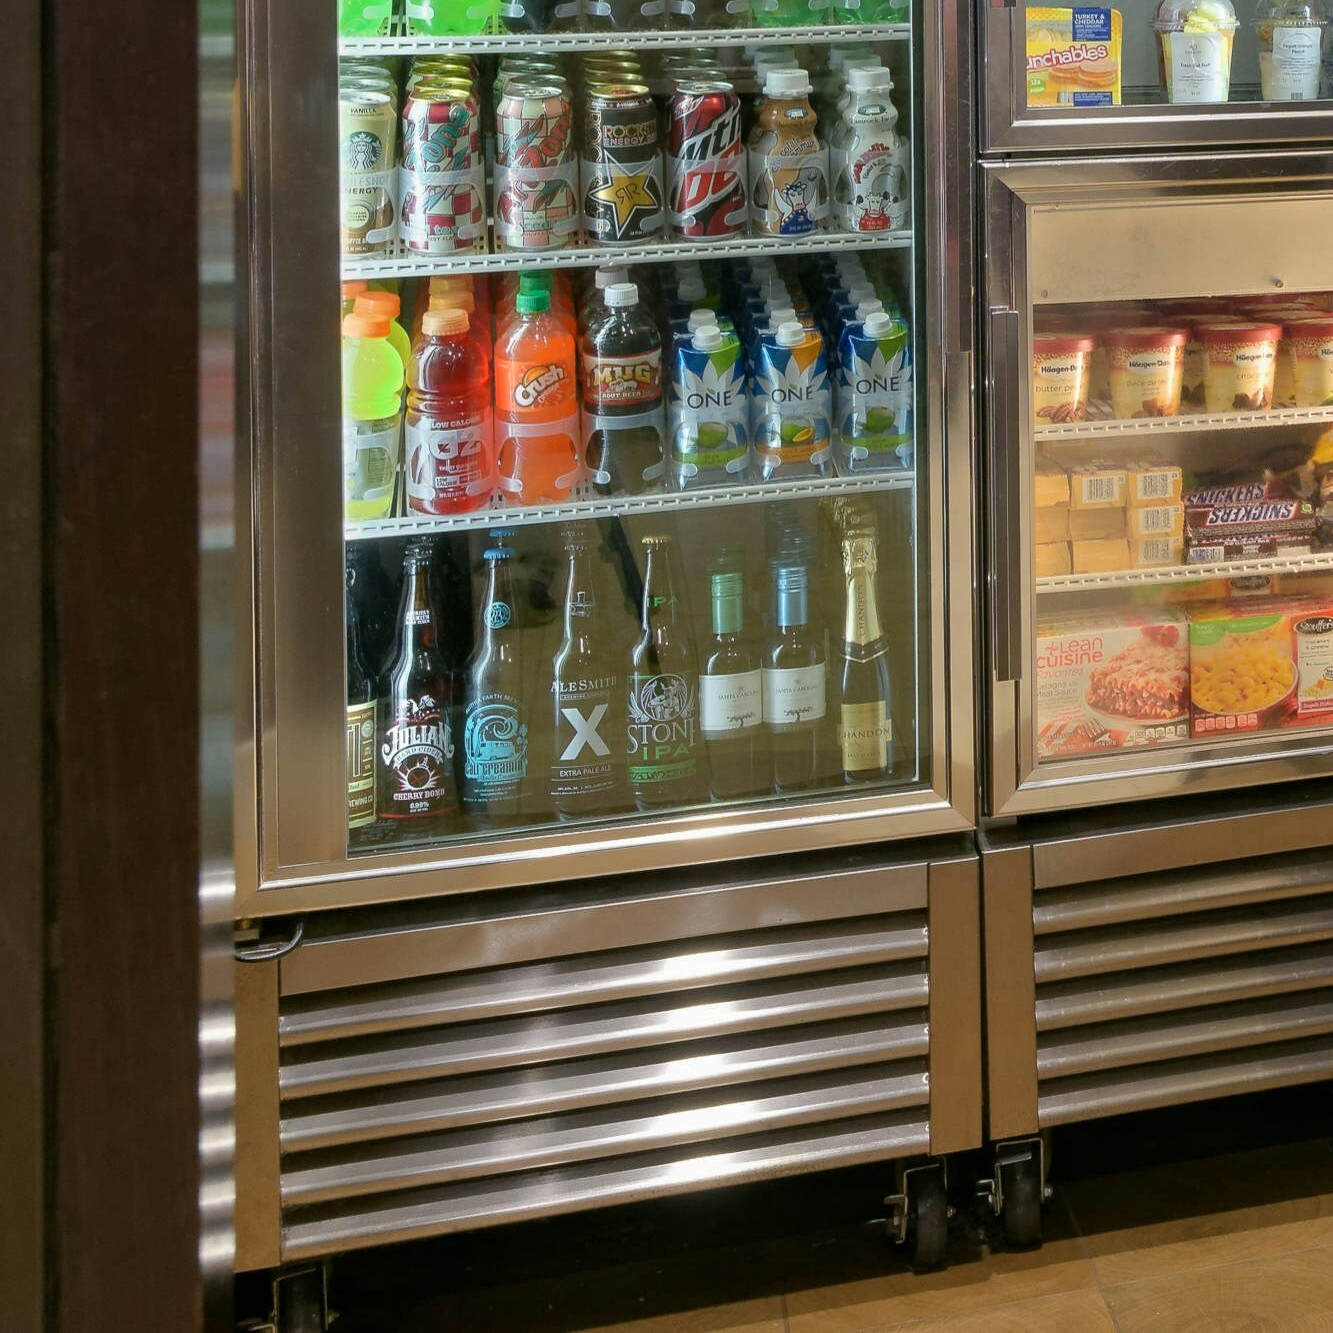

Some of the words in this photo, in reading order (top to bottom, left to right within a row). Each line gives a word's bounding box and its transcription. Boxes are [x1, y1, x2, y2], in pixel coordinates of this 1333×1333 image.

[1074, 18, 1104, 26] CHEDDAR
[1026, 45, 1107, 69] unchables
[350, 106, 377, 114] VANILLA
[593, 364, 650, 386] MUG
[513, 364, 566, 407] Crush
[622, 390, 642, 398] BEER
[771, 385, 814, 403] ONE
[856, 377, 900, 395] ONE
[687, 390, 733, 410] ONE
[430, 419, 449, 429] LOW
[1208, 503, 1297, 525] SNICKERS
[857, 586, 865, 637] CHANDON
[1059, 637, 1103, 654] Lean
[560, 703, 612, 761] X
[839, 727, 890, 740] CHANDON
[381, 721, 454, 766] JULIAN
[642, 744, 689, 761] IPA
[559, 769, 582, 778] EXTRA
[582, 768, 599, 776] PALE
[600, 765, 612, 773] ALE
[393, 790, 423, 801] CHERRY
[424, 788, 446, 799] BOMB
